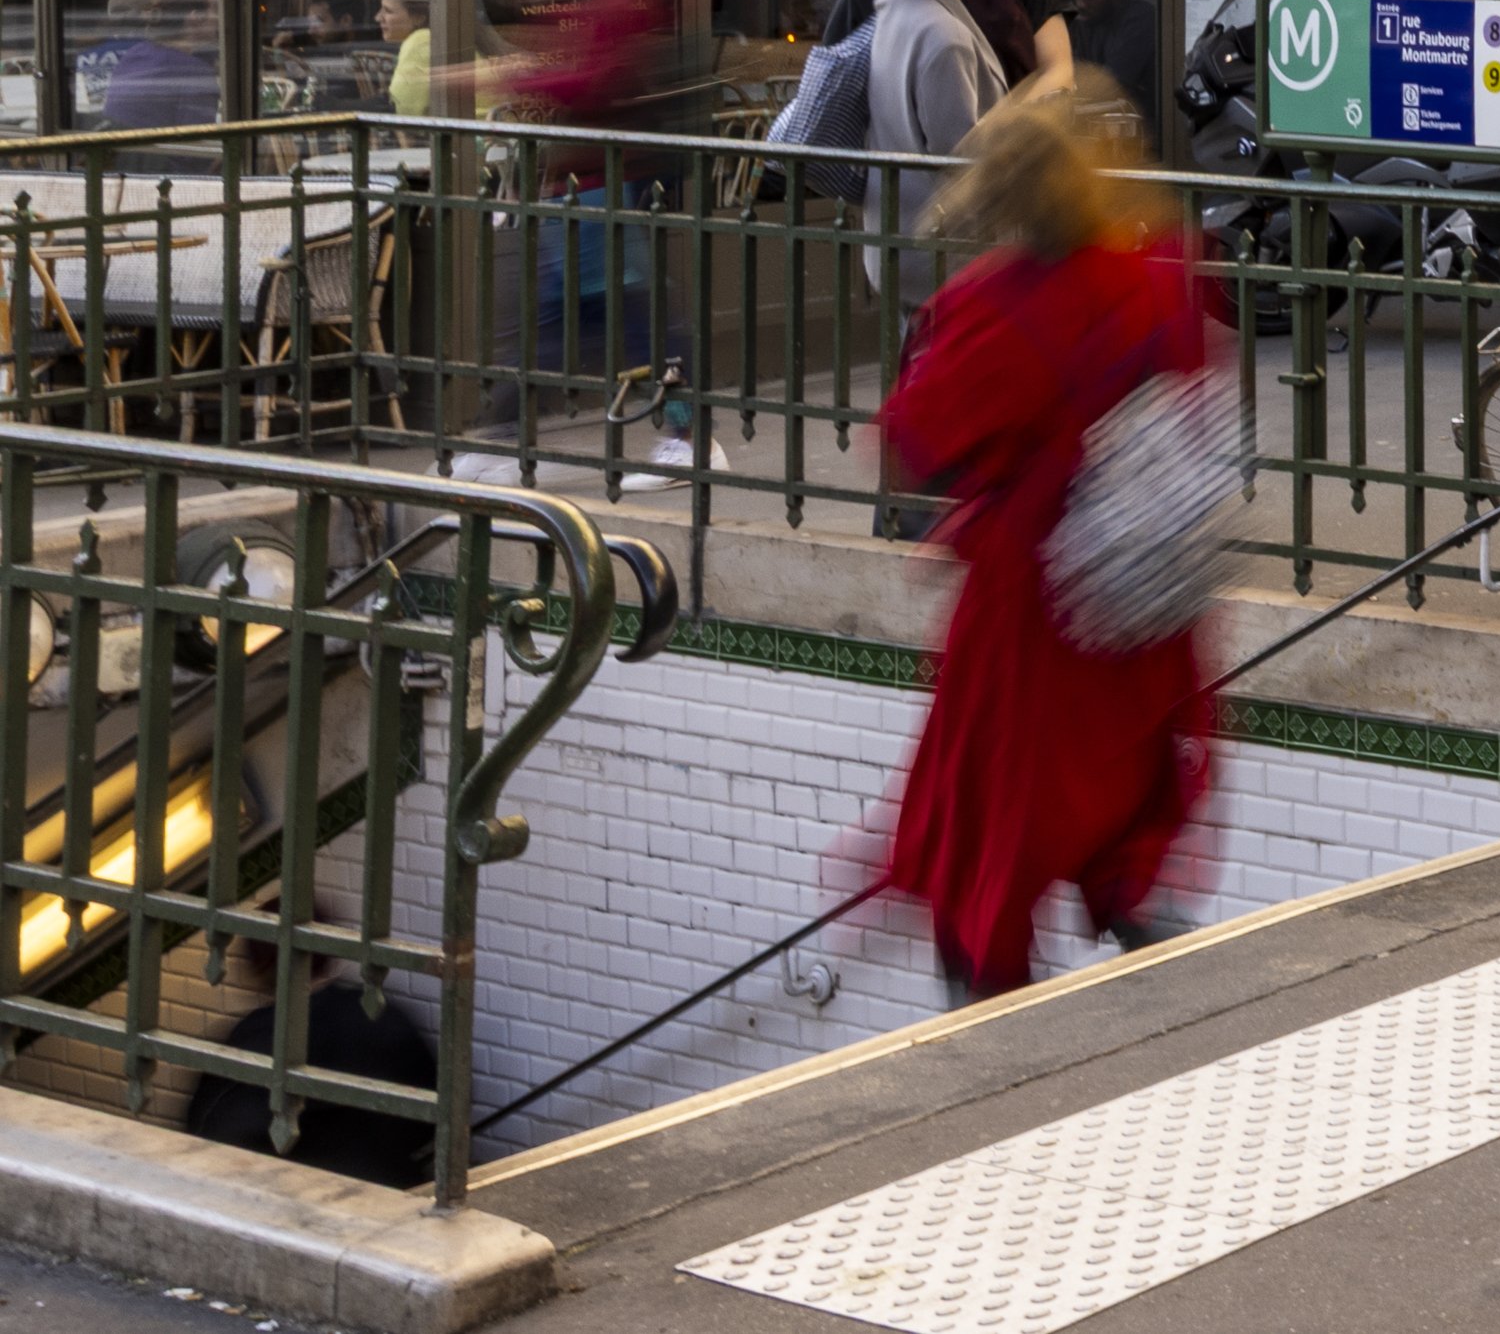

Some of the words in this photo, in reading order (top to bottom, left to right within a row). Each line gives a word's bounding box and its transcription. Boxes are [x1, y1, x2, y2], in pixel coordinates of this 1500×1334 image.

[1382, 17, 1392, 38] 1
[1402, 15, 1421, 29] rue
[1489, 21, 1500, 42] 8
[1280, 6, 1321, 67] M
[1402, 29, 1416, 46] du
[1419, 31, 1471, 52] Faubourg
[1402, 47, 1469, 66] Montmartre
[1489, 67, 1500, 87] 9
